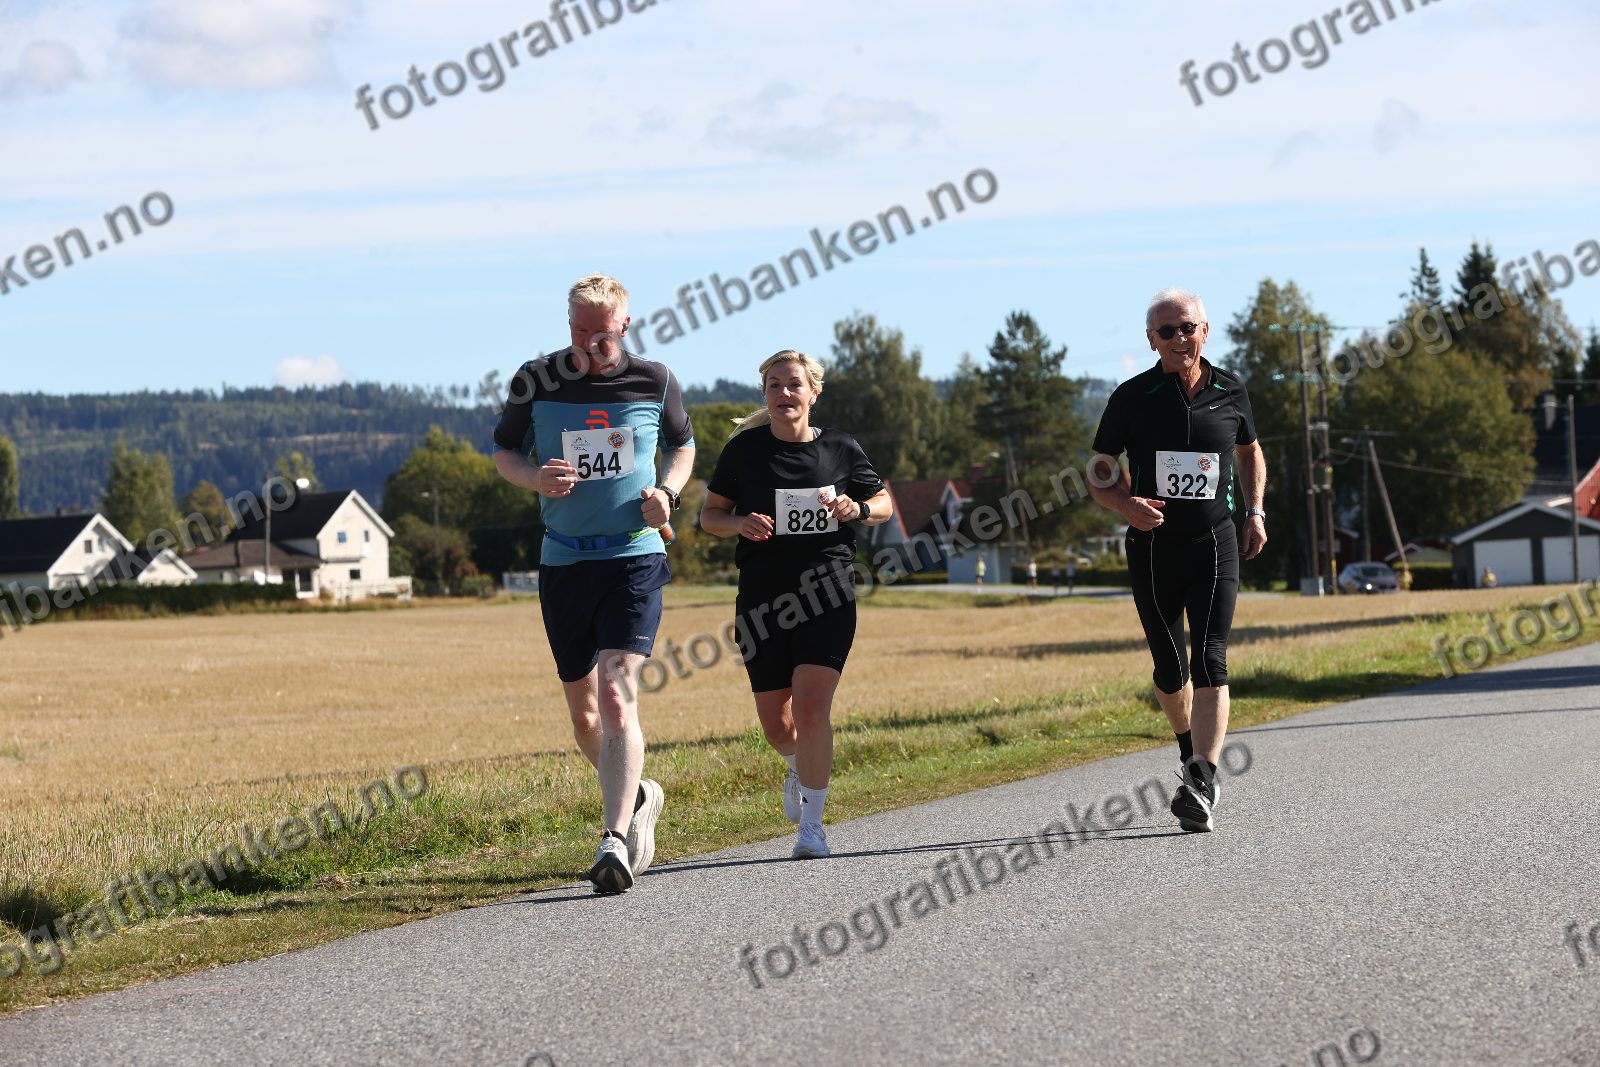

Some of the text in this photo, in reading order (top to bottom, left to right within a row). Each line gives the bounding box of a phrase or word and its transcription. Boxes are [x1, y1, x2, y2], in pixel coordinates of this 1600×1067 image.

[577, 451, 622, 479] 544
[1167, 473, 1208, 497] 322
[787, 508, 829, 532] 828
